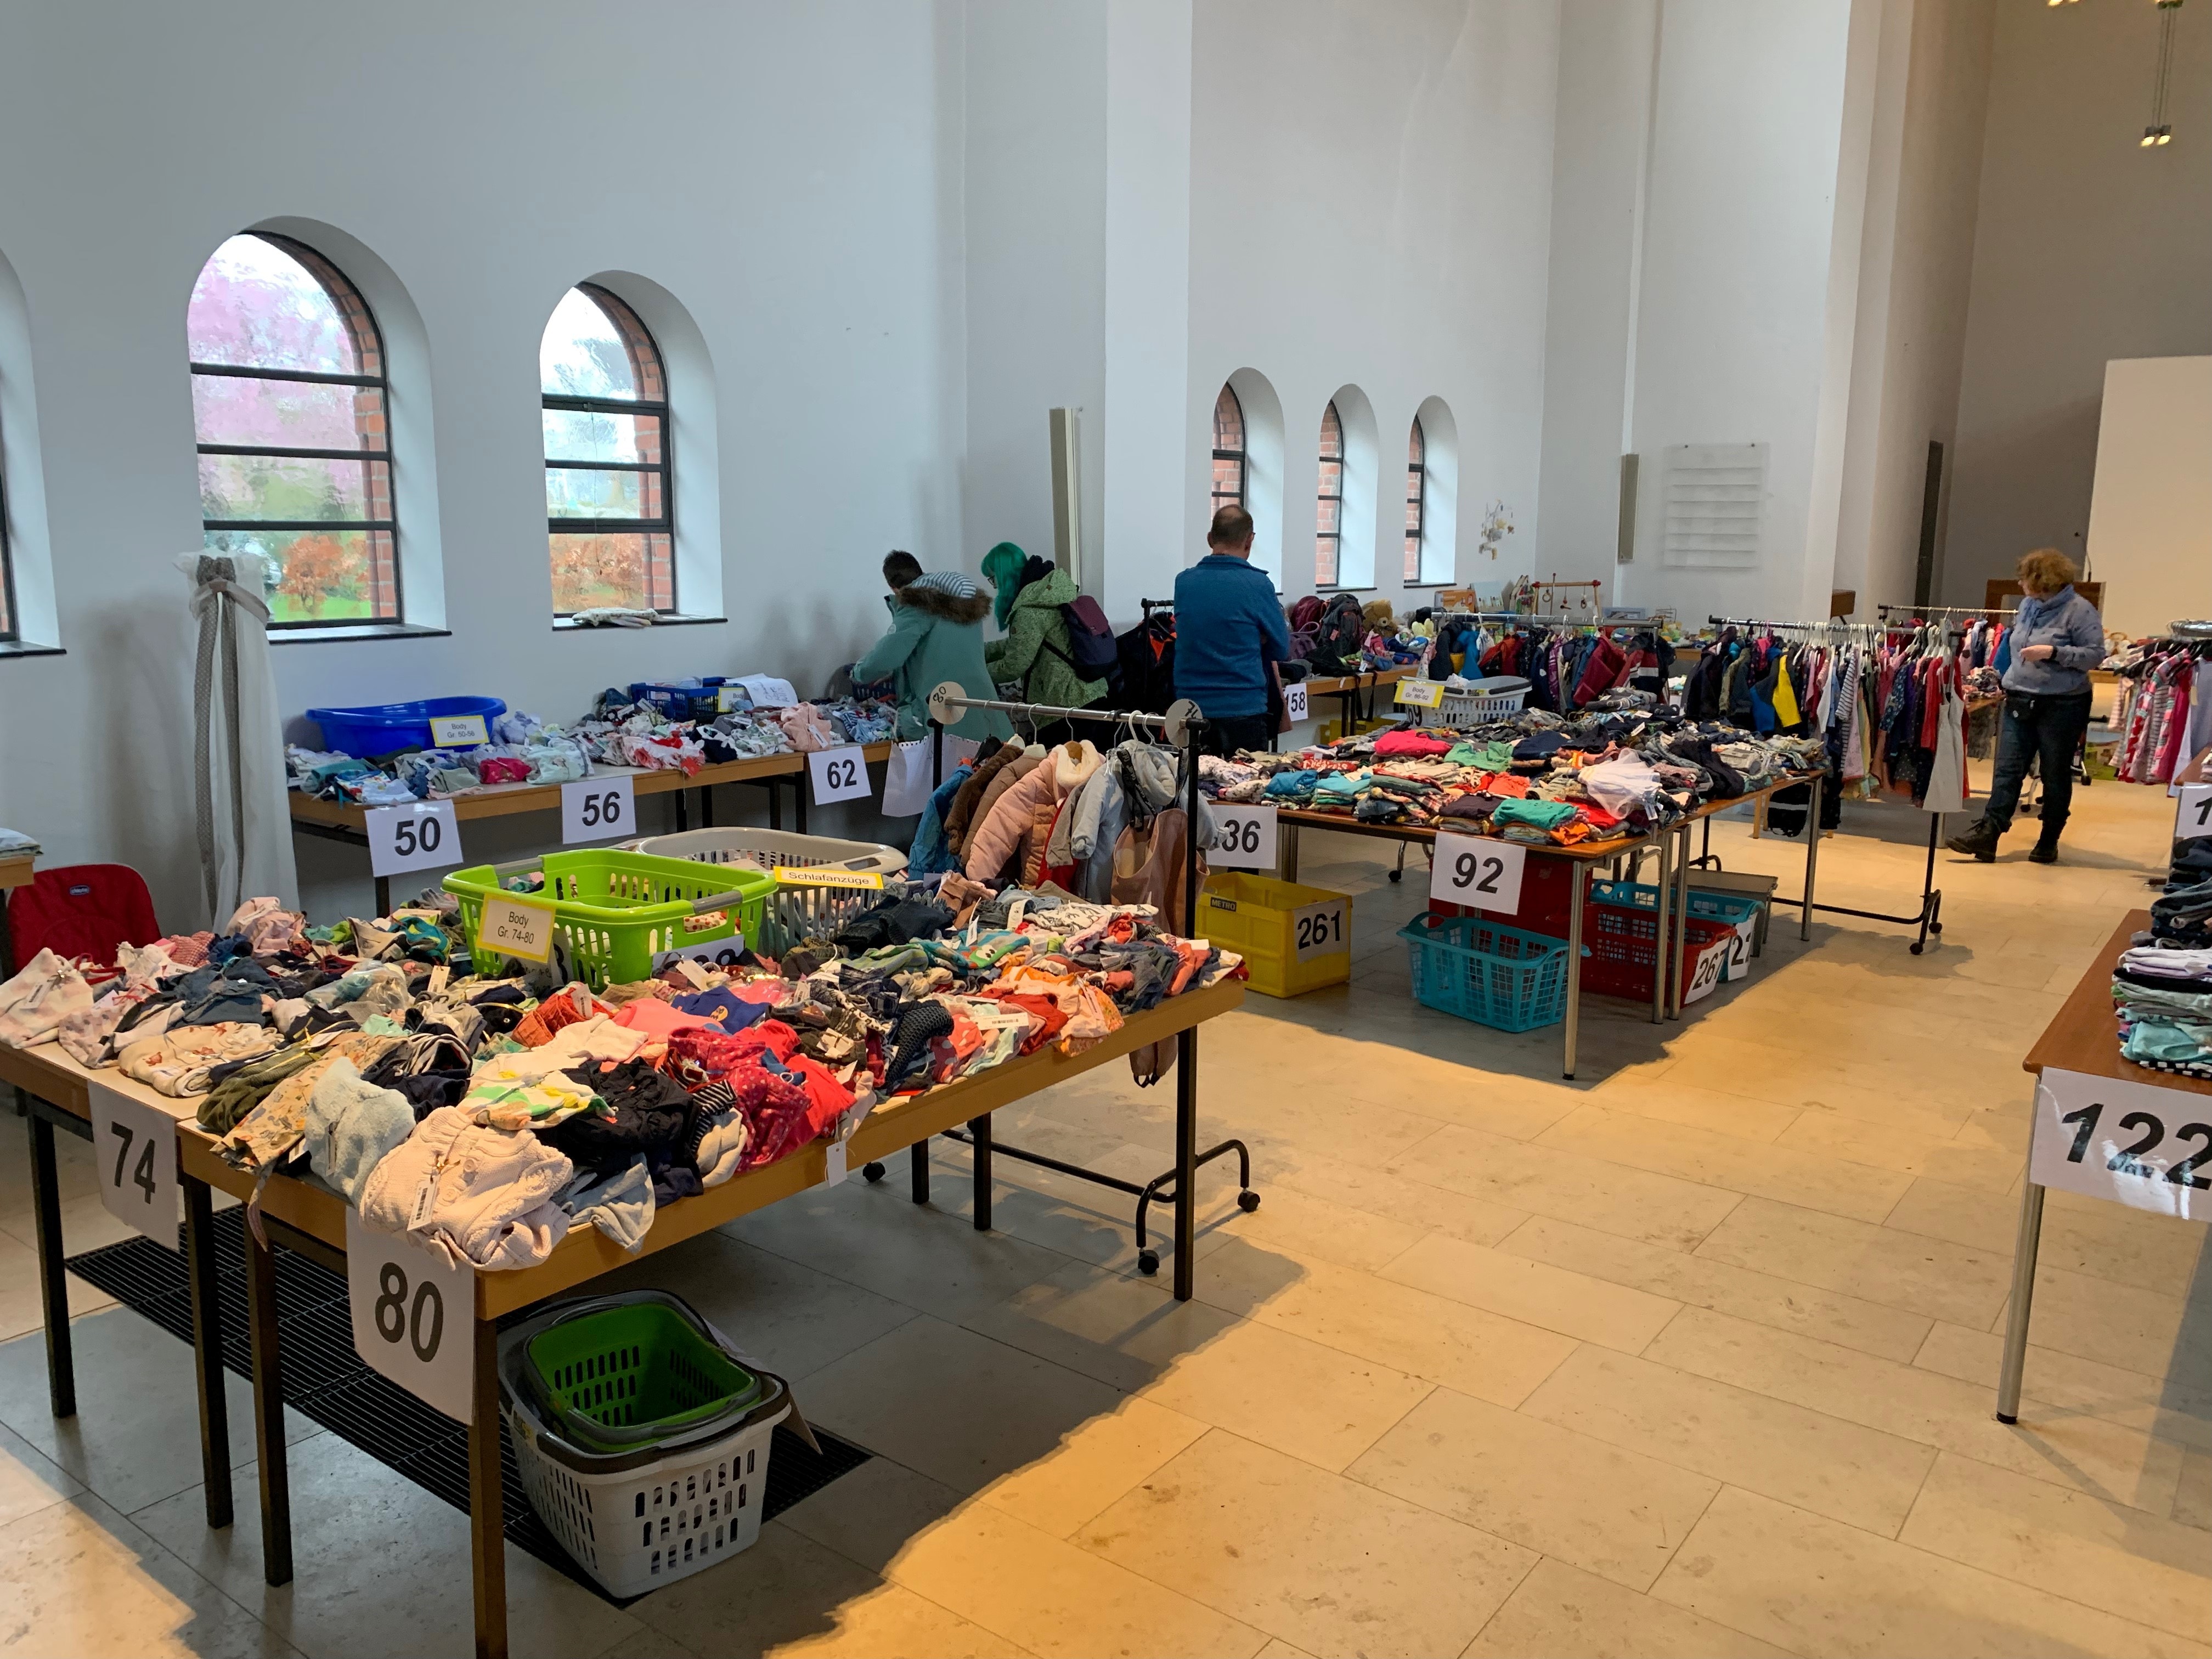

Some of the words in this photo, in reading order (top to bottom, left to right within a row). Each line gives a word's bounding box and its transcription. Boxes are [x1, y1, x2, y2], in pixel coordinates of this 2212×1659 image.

[933, 686, 946, 703] 80
[827, 759, 857, 789] 62
[582, 791, 620, 826] 56
[394, 816, 441, 856] 50
[788, 872, 869, 885] Schlafanzüge
[1452, 853, 1503, 894] 92
[509, 911, 529, 928] Body
[1211, 898, 1235, 910] METRO
[498, 926, 509, 939] Gr.
[512, 929, 534, 944] 74-80
[1297, 910, 1340, 950] 261
[111, 1121, 155, 1204] 74
[2062, 1103, 2212, 1190] 122
[375, 1262, 444, 1362] 80
